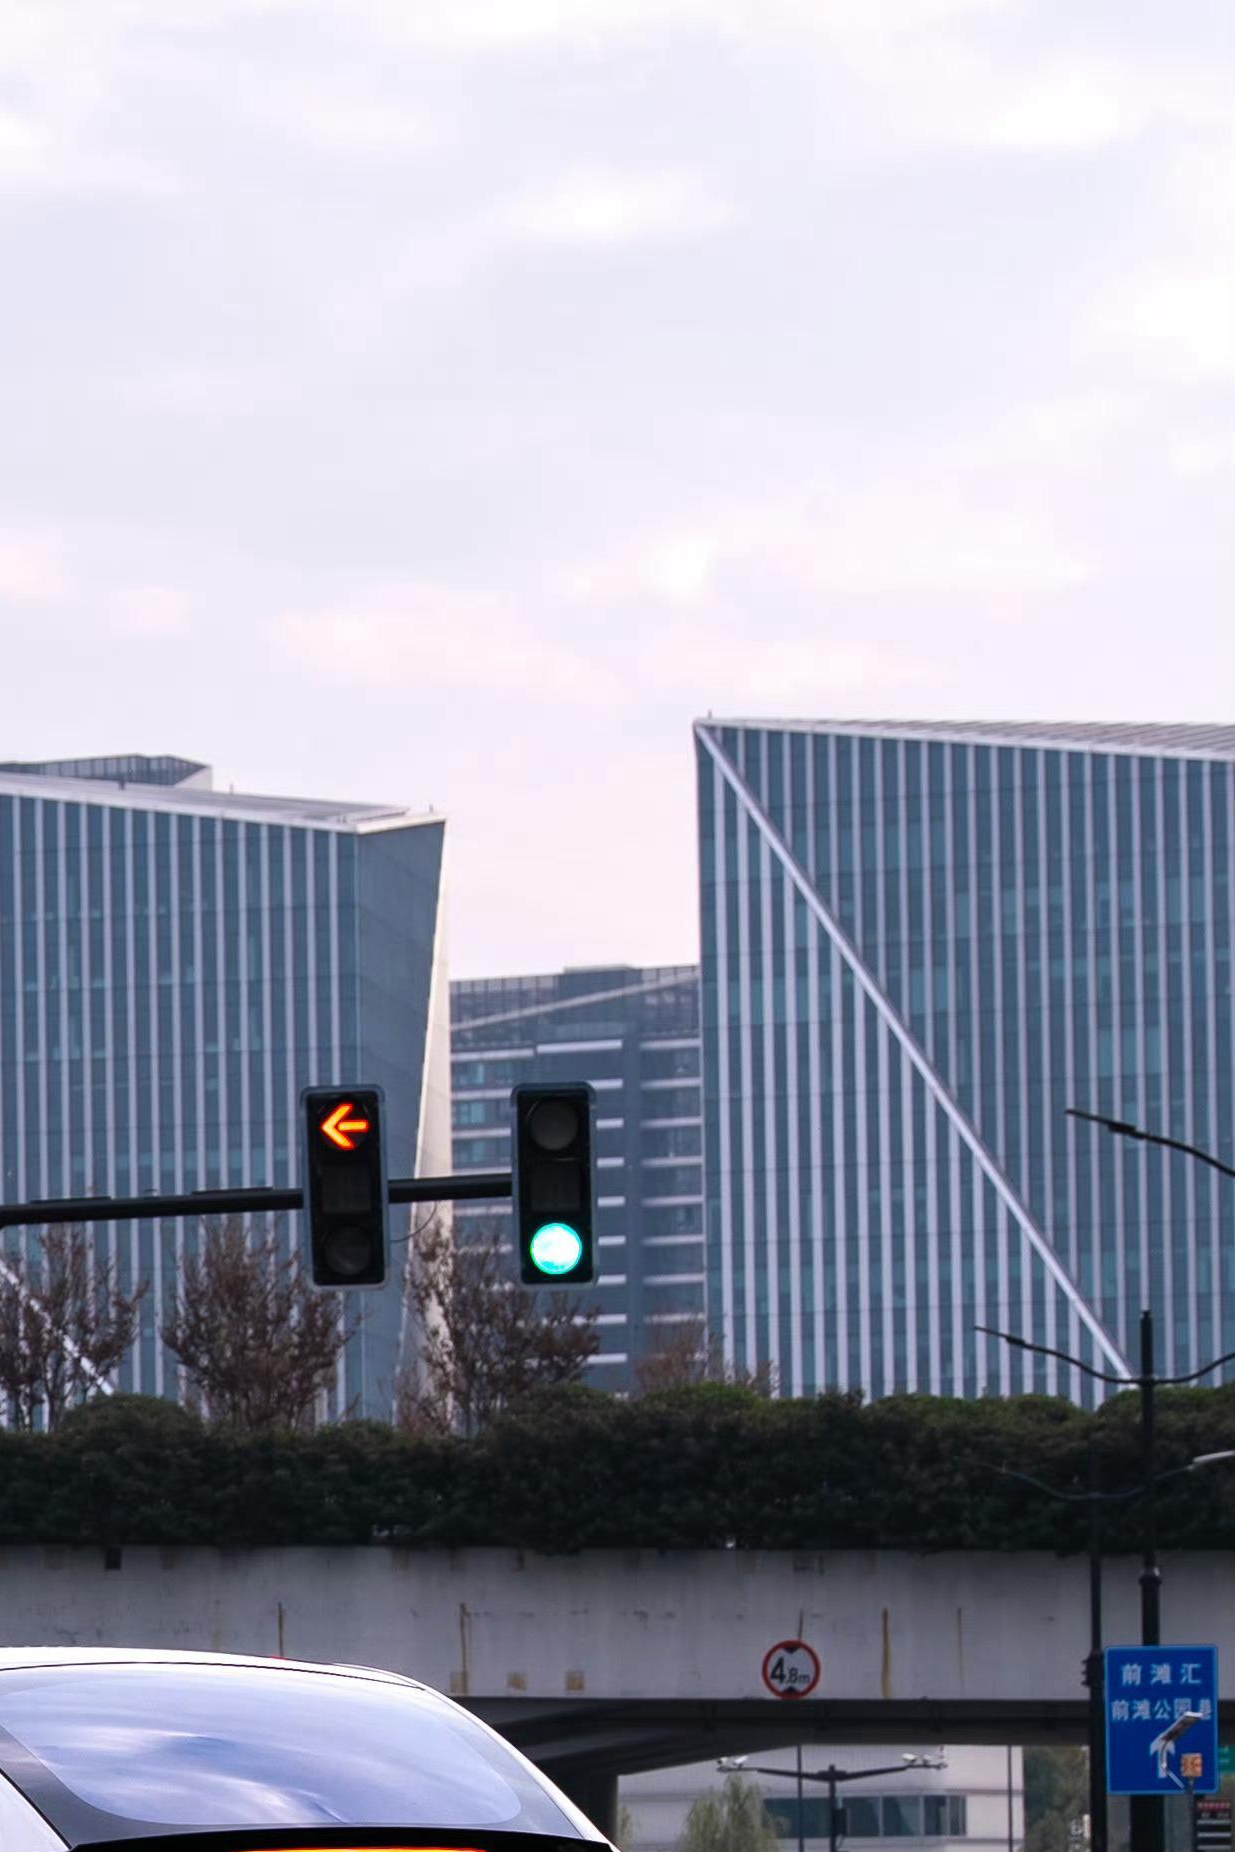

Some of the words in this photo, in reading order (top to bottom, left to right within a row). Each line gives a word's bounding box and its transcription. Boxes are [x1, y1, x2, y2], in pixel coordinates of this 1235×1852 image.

[770, 1656, 811, 1684] 4.8m
[1121, 1663, 1202, 1686] 前滩汇
